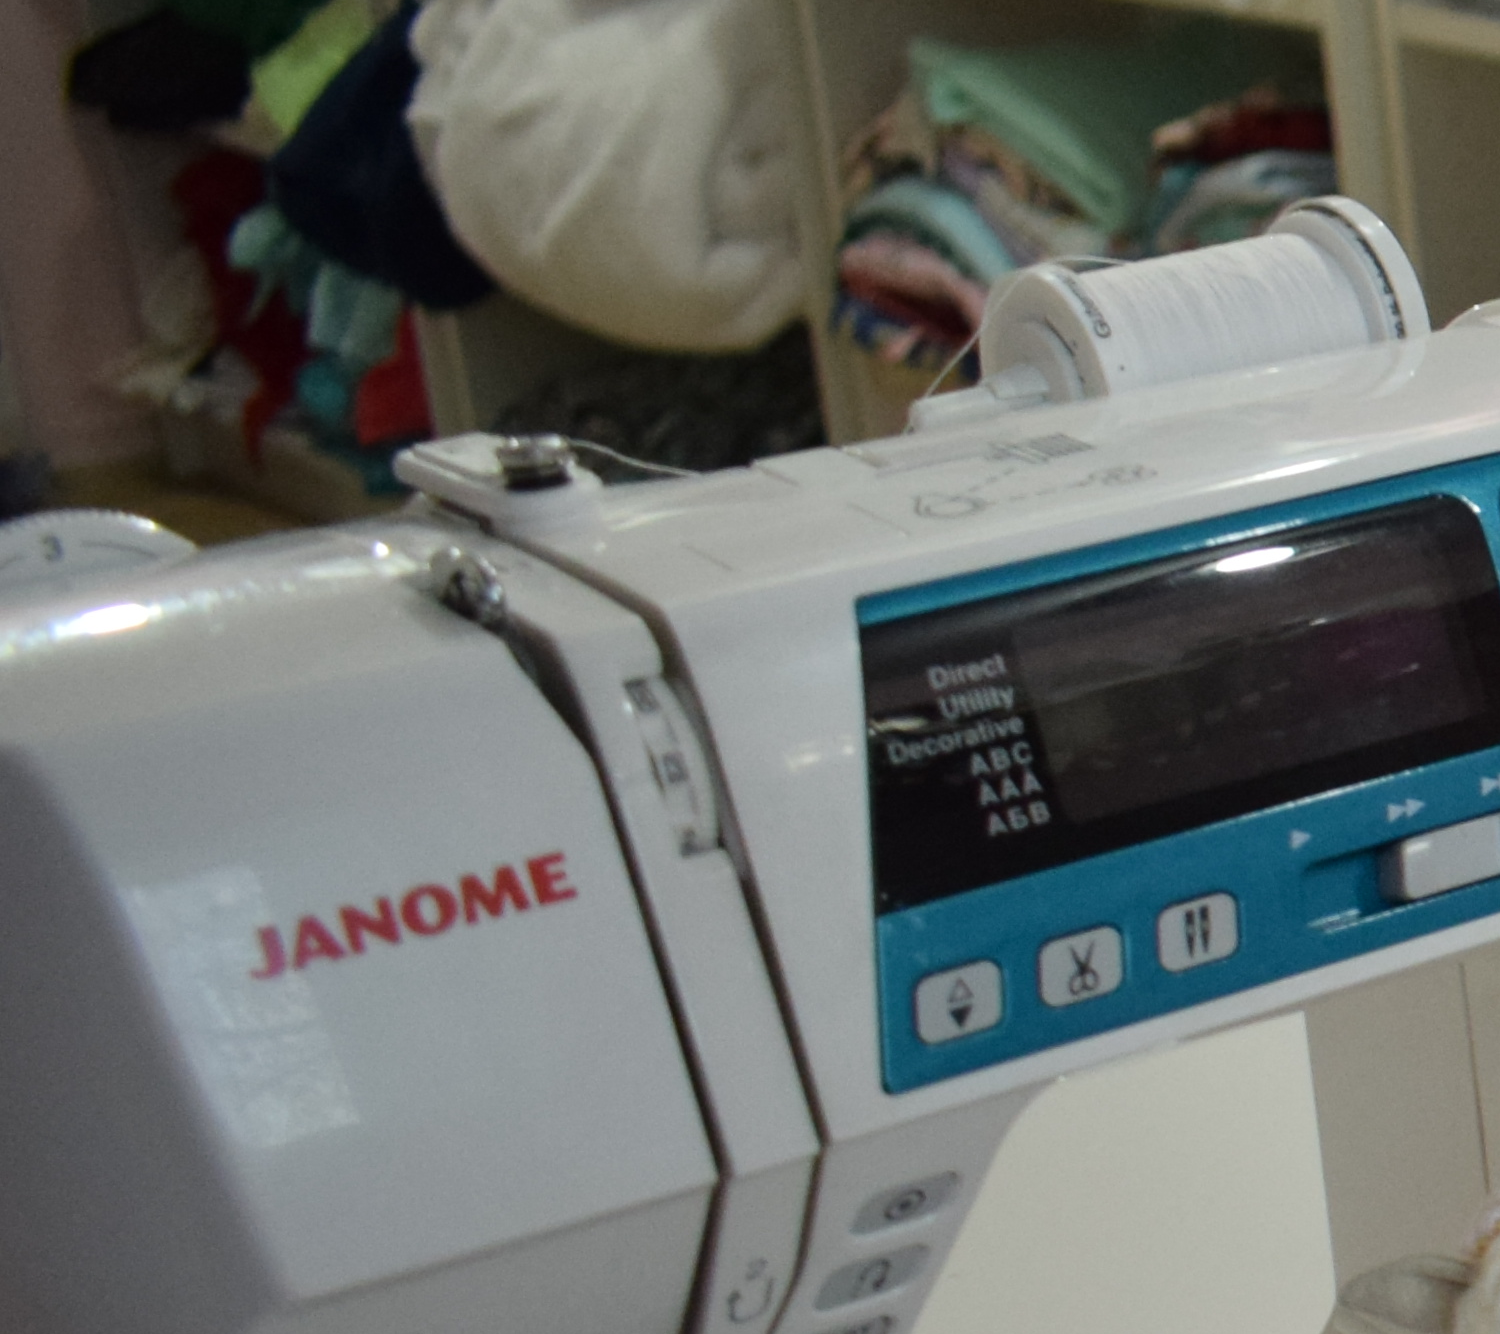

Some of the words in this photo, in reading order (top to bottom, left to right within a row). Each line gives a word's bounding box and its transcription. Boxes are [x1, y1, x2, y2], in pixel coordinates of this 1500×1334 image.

[926, 653, 1007, 690] Direct
[938, 685, 1014, 721] Utility
[887, 717, 1024, 765] Decorative
[970, 741, 1034, 776] ABC
[249, 851, 578, 980] JANOME
